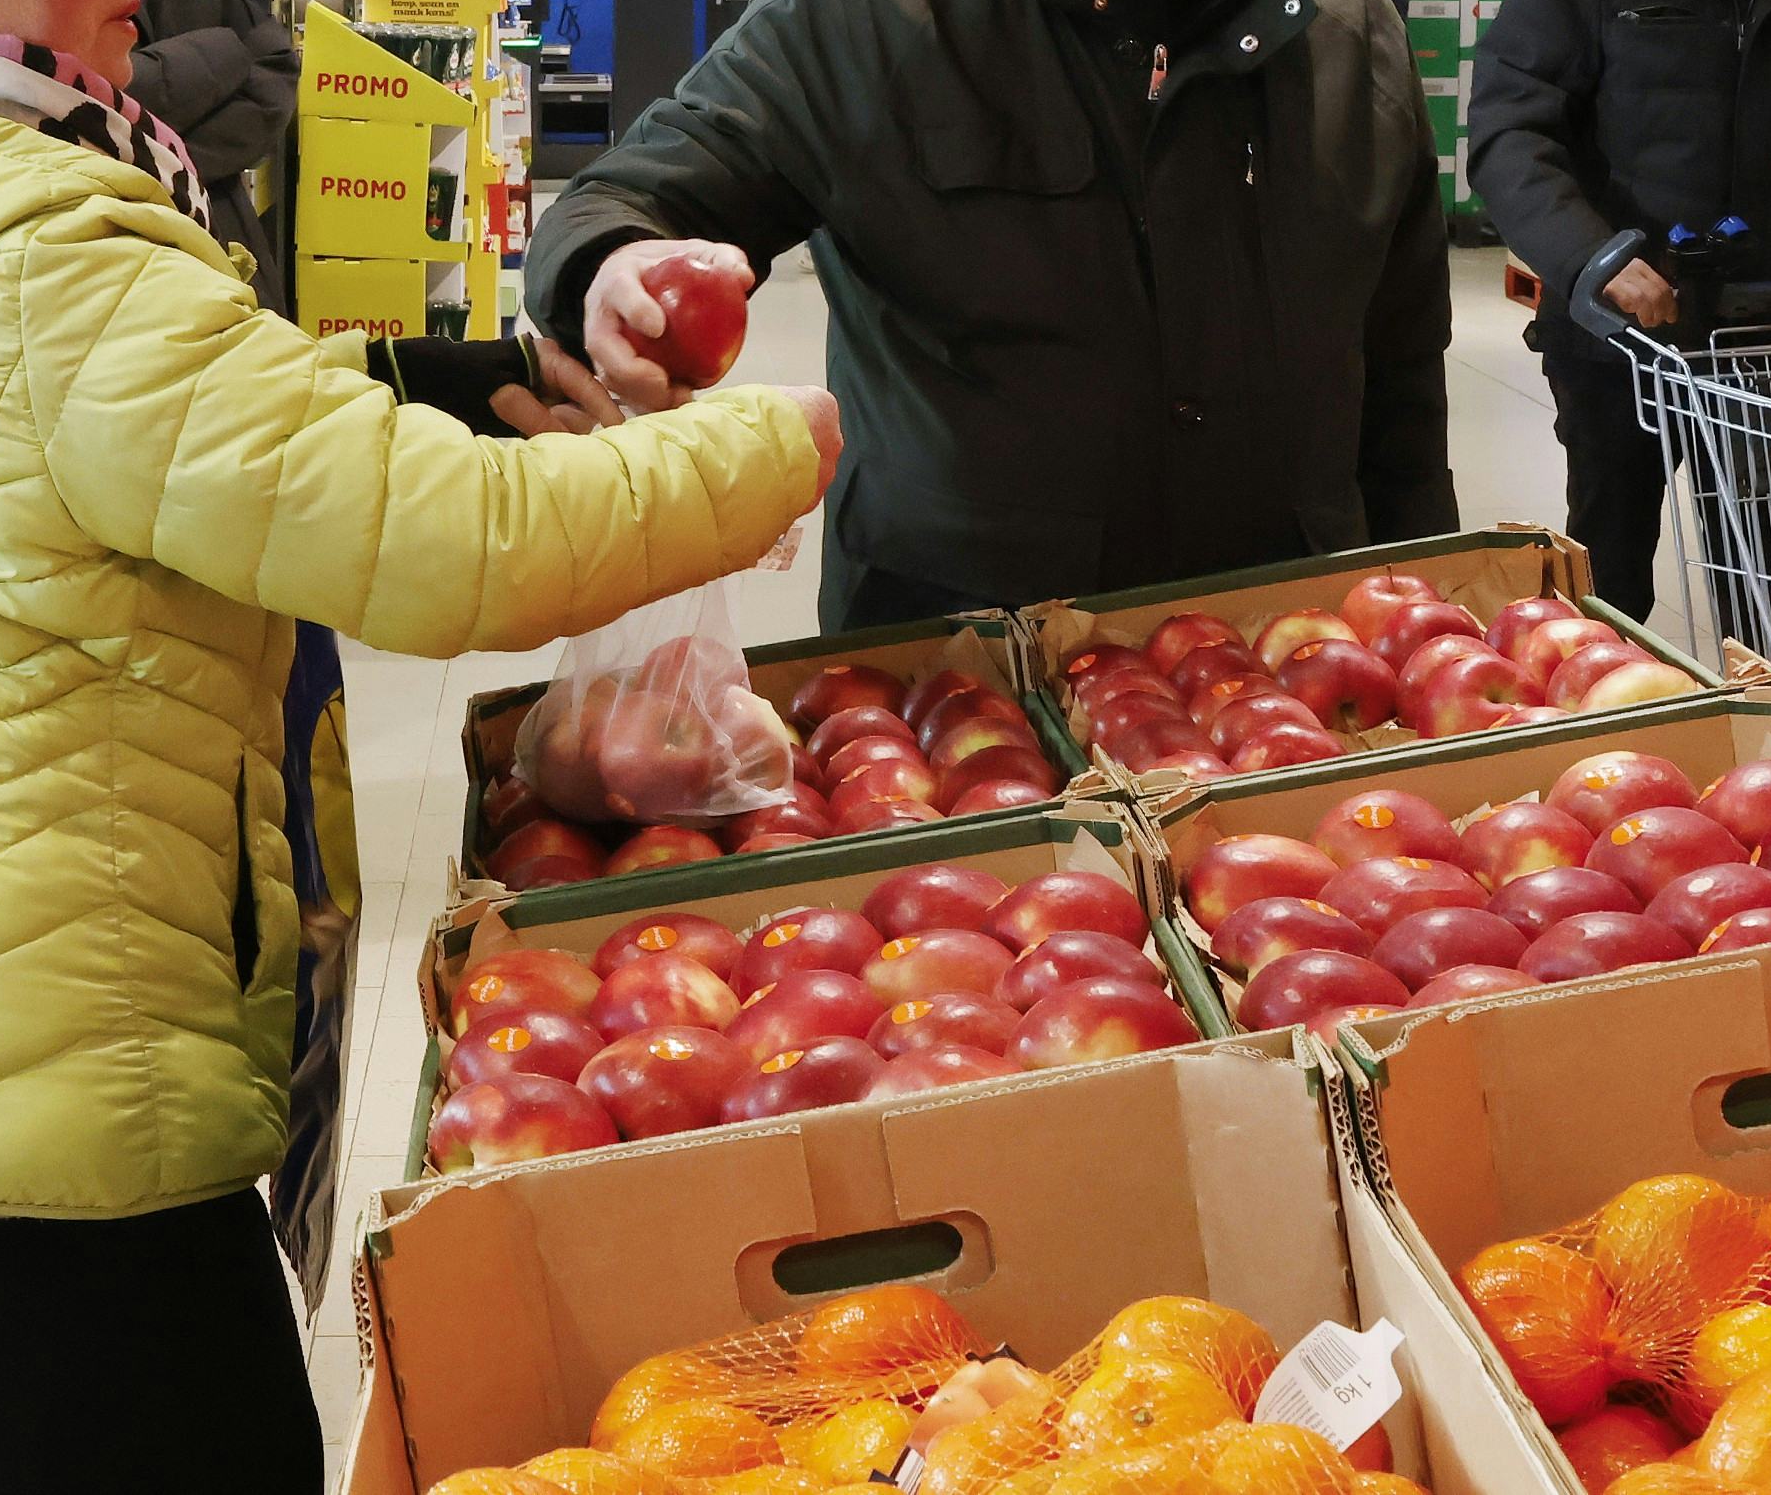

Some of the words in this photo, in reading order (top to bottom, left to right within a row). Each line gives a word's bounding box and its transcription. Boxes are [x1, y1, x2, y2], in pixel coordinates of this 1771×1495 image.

[393, 8, 424, 17] maak
[317, 72, 409, 99] PROMO
[320, 176, 407, 201] PROMO
[1358, 1373, 1373, 1388] 1
[1333, 1383, 1364, 1405] kg
